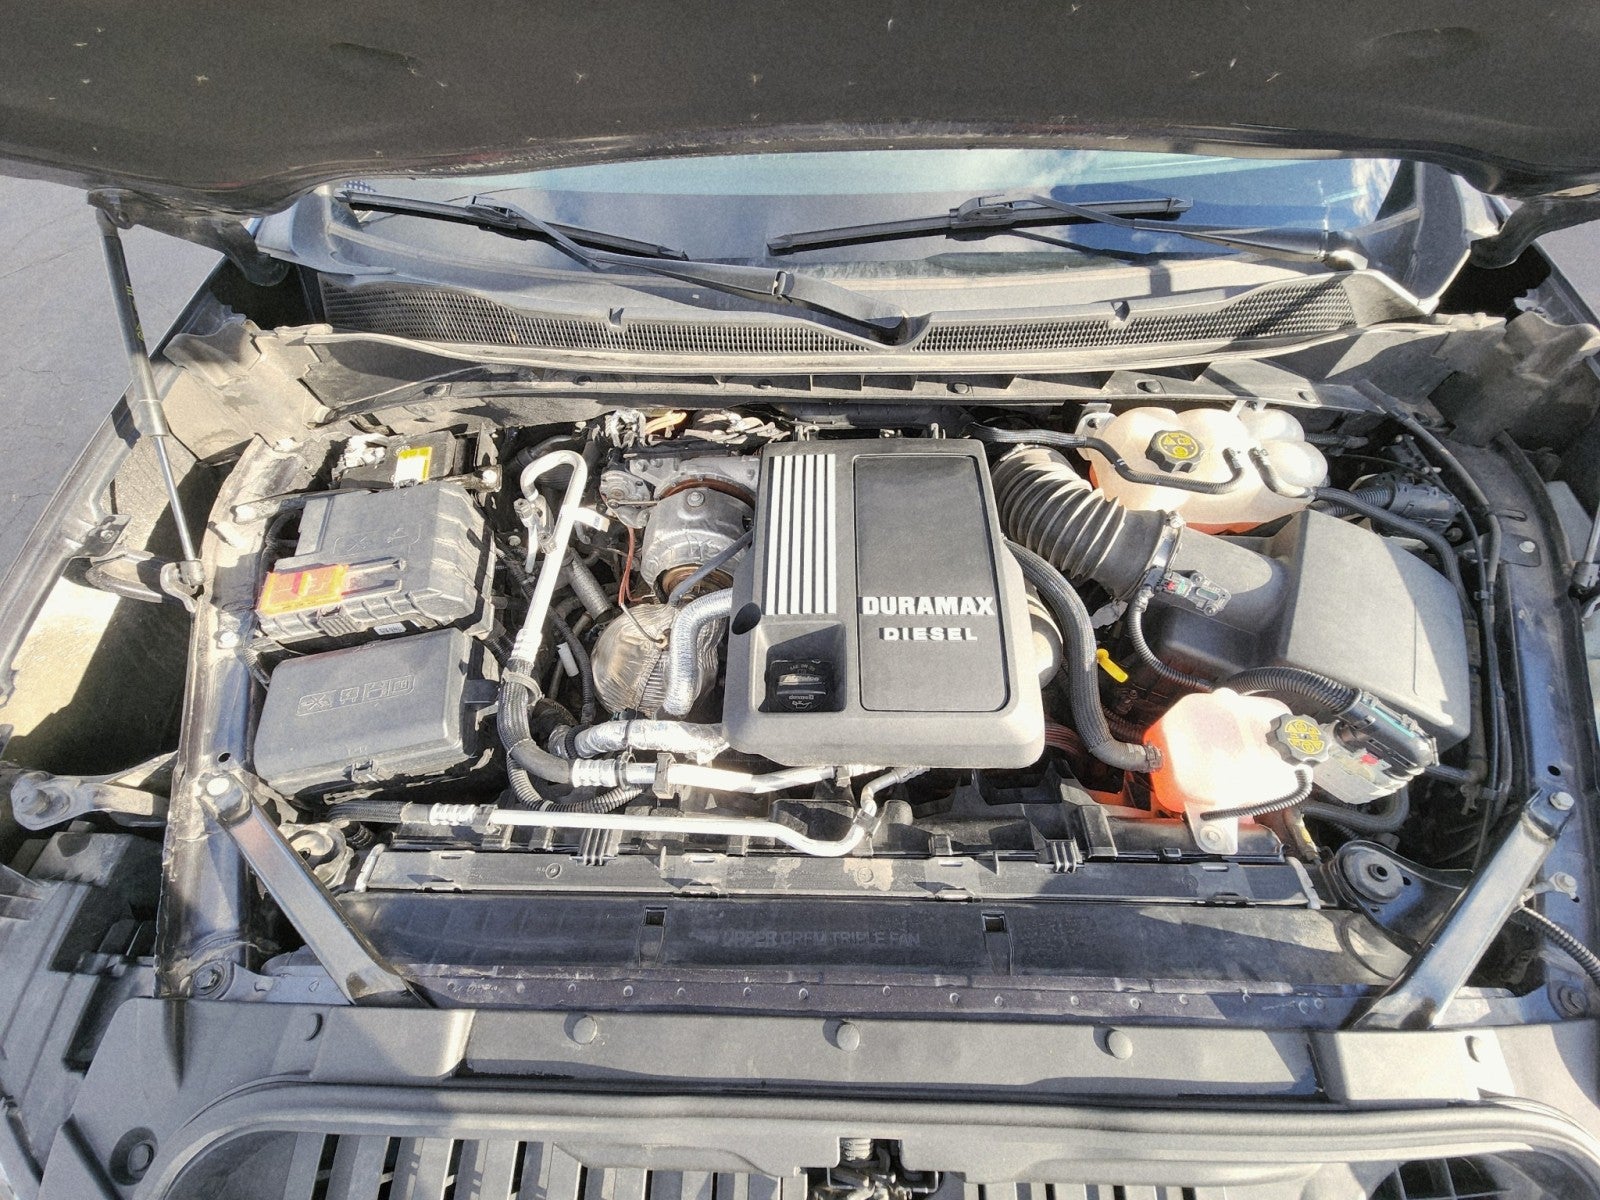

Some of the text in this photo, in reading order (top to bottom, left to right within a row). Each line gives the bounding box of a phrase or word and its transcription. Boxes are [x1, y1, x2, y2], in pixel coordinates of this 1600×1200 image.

[860, 596, 996, 616] DURAMAX
[881, 626, 978, 642] DIESEL
[722, 930, 778, 948] UPPER
[831, 930, 886, 946] TRIPLE
[890, 930, 921, 947] FAN
